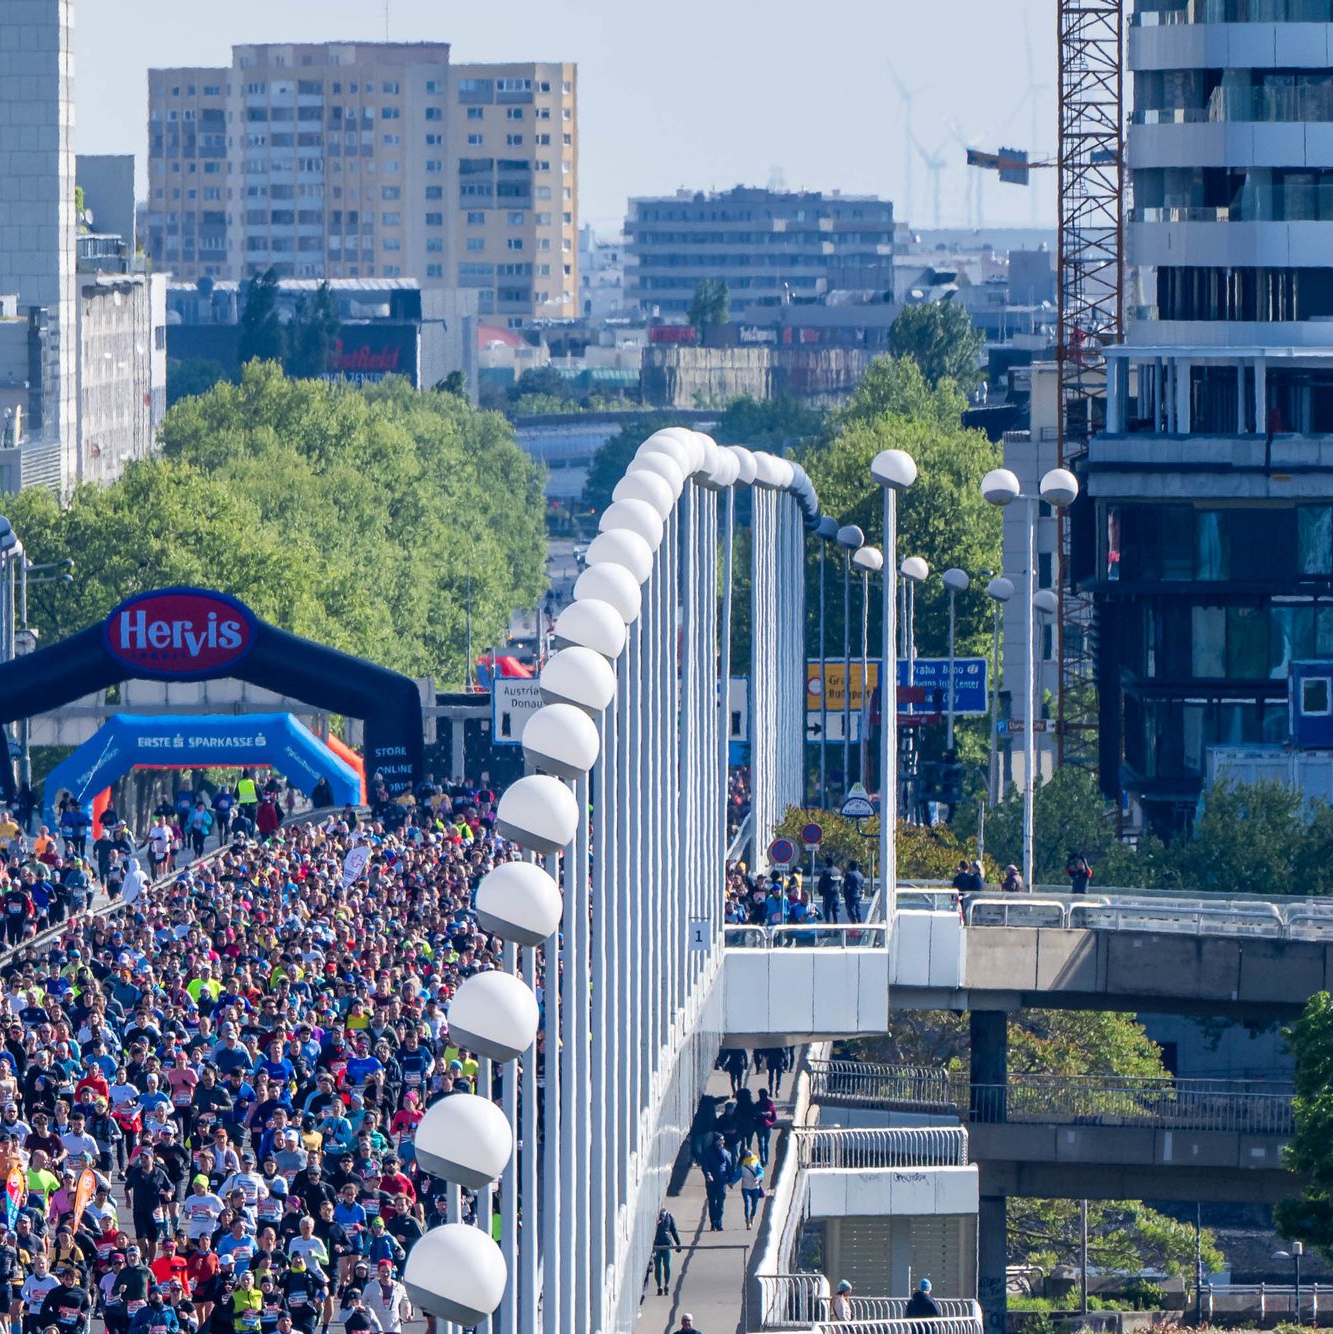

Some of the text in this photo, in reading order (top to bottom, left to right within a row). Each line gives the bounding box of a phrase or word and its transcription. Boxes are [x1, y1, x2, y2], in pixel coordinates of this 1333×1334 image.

[120, 610, 243, 657] Hervis
[504, 686, 539, 696] Austria
[137, 737, 254, 748] ERSTE SPARKASSE
[375, 746, 407, 758] STORE
